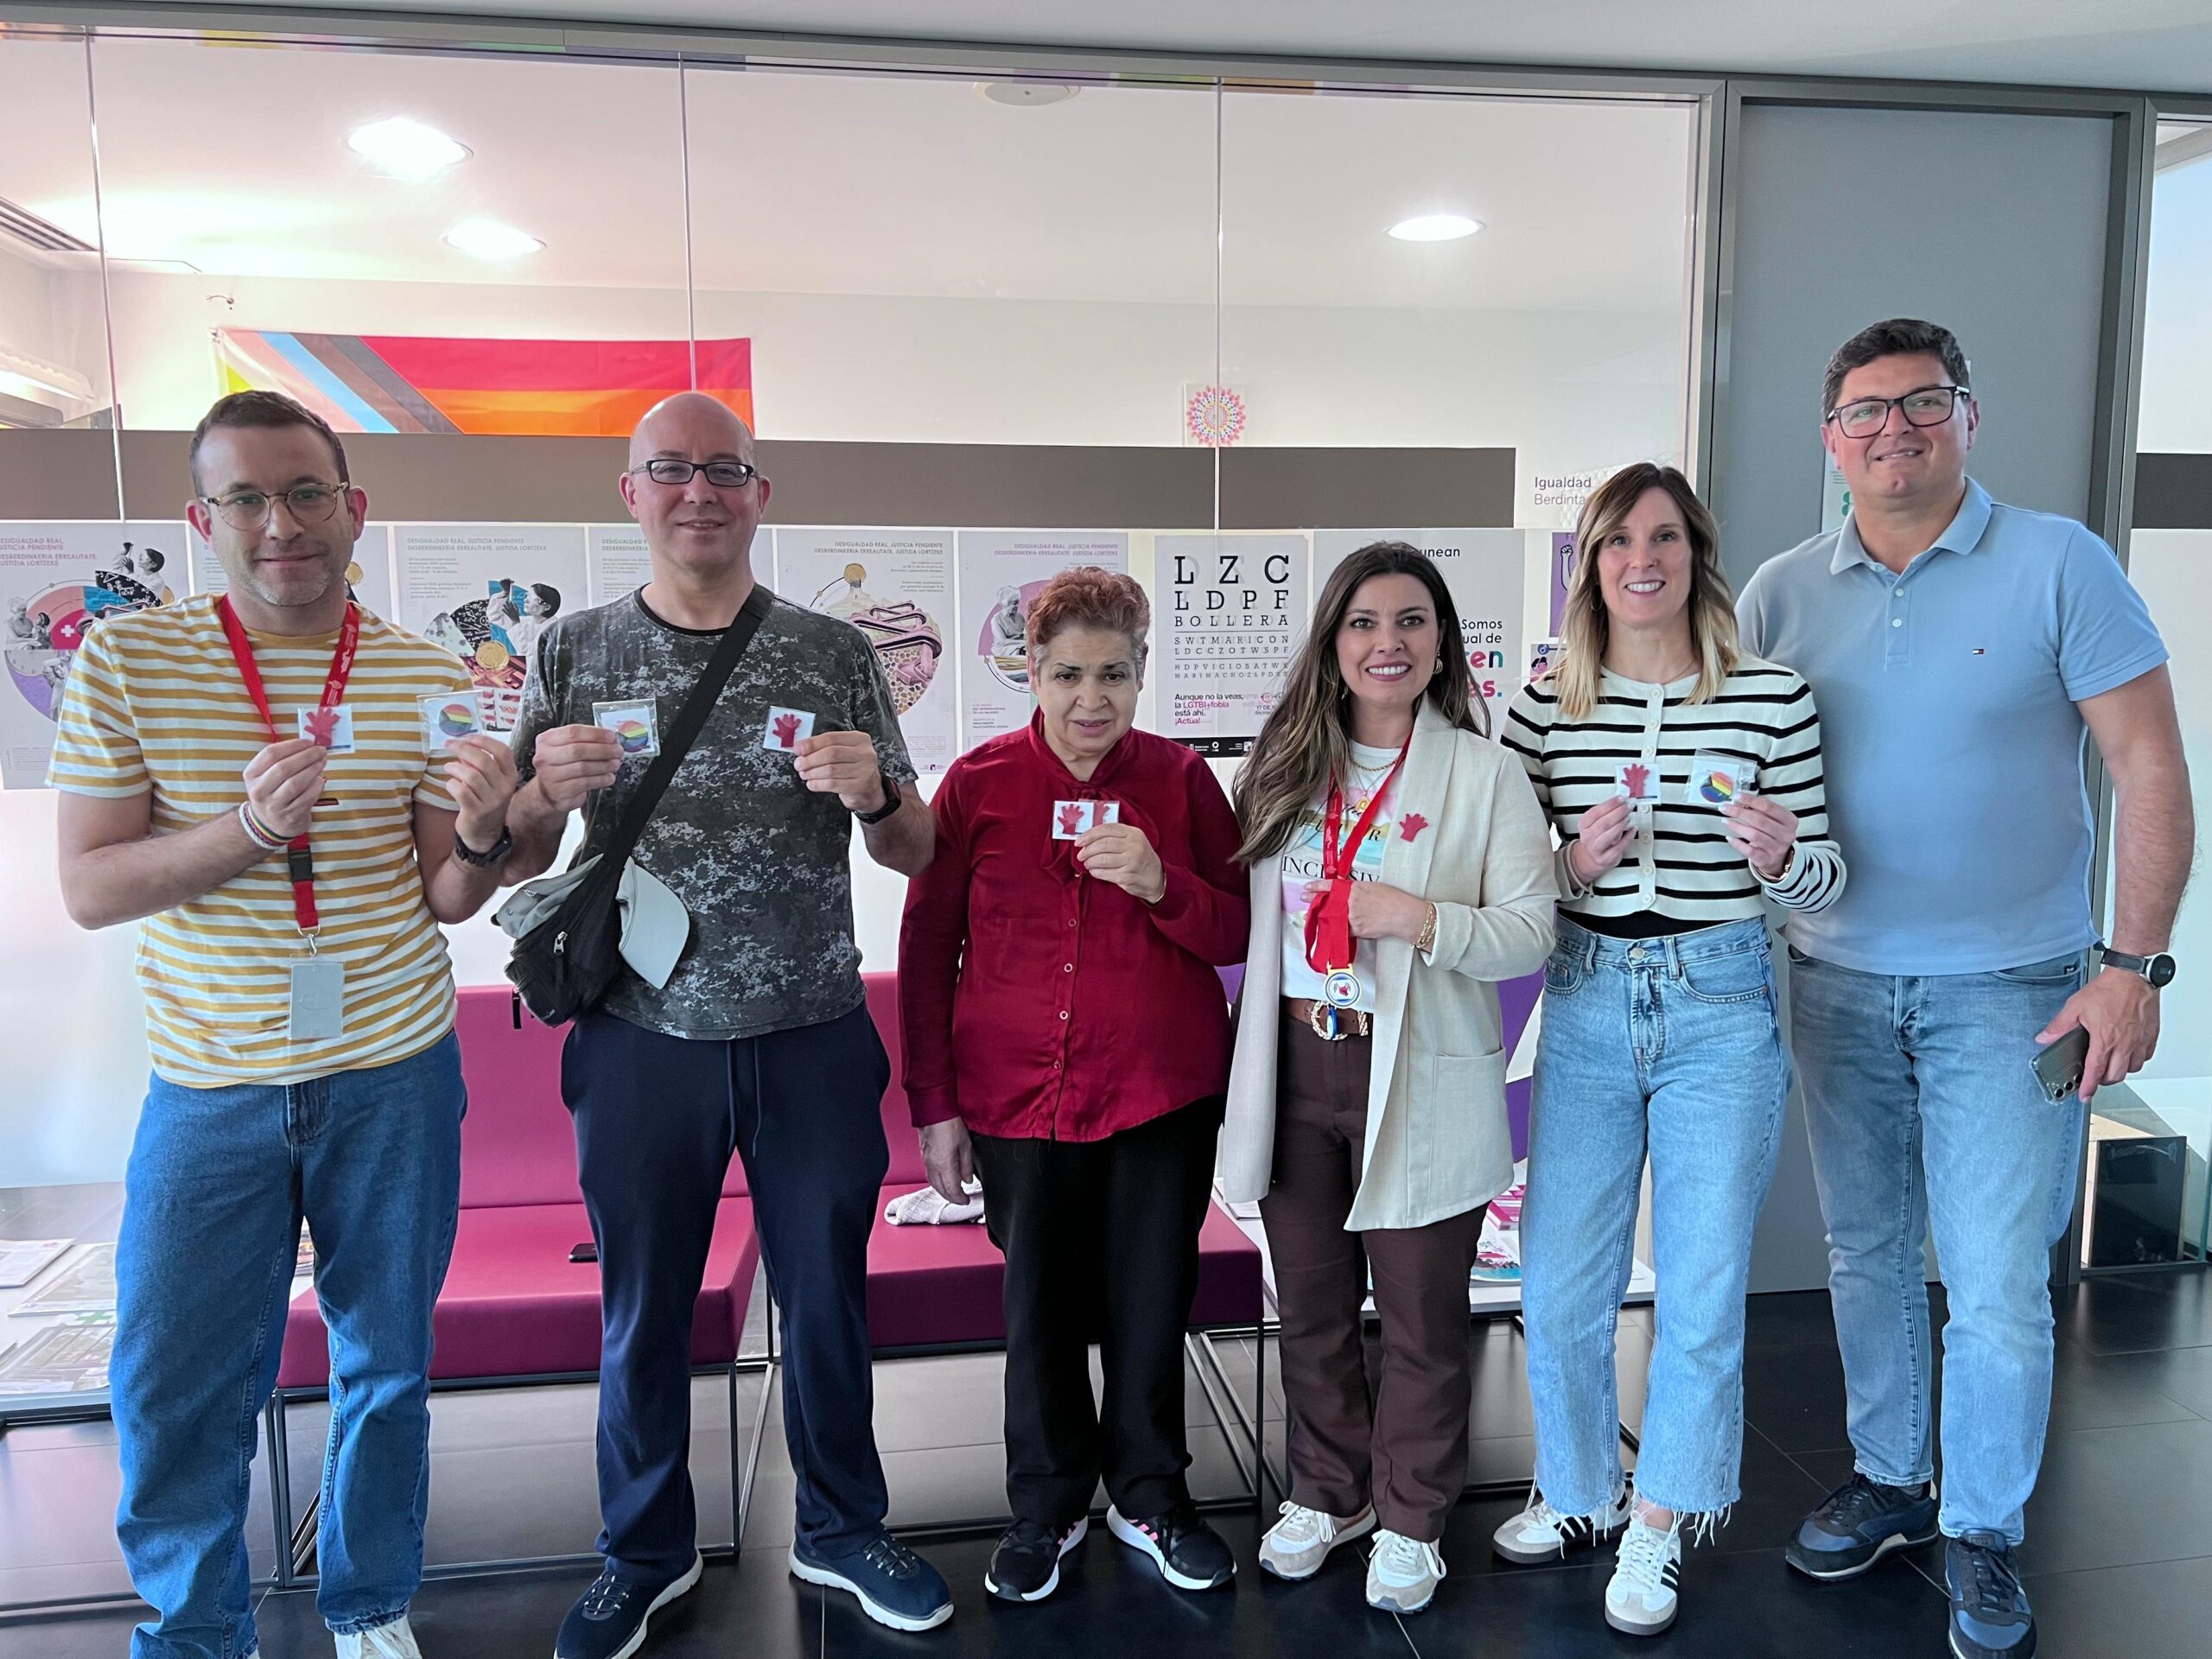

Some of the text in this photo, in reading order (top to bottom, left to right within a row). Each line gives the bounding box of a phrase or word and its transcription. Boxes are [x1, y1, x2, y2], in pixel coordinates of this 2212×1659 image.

[1535, 476, 1592, 491] Igualdad
[1534, 493, 1586, 505] Berdinta
[1565, 532, 1577, 541] FE
[1420, 547, 1461, 557] unean
[1461, 619, 1503, 630] Somos
[1463, 633, 1502, 644] ual de
[1174, 693, 1204, 702] Aunque
[1175, 717, 1201, 726] ¡Actúa!
